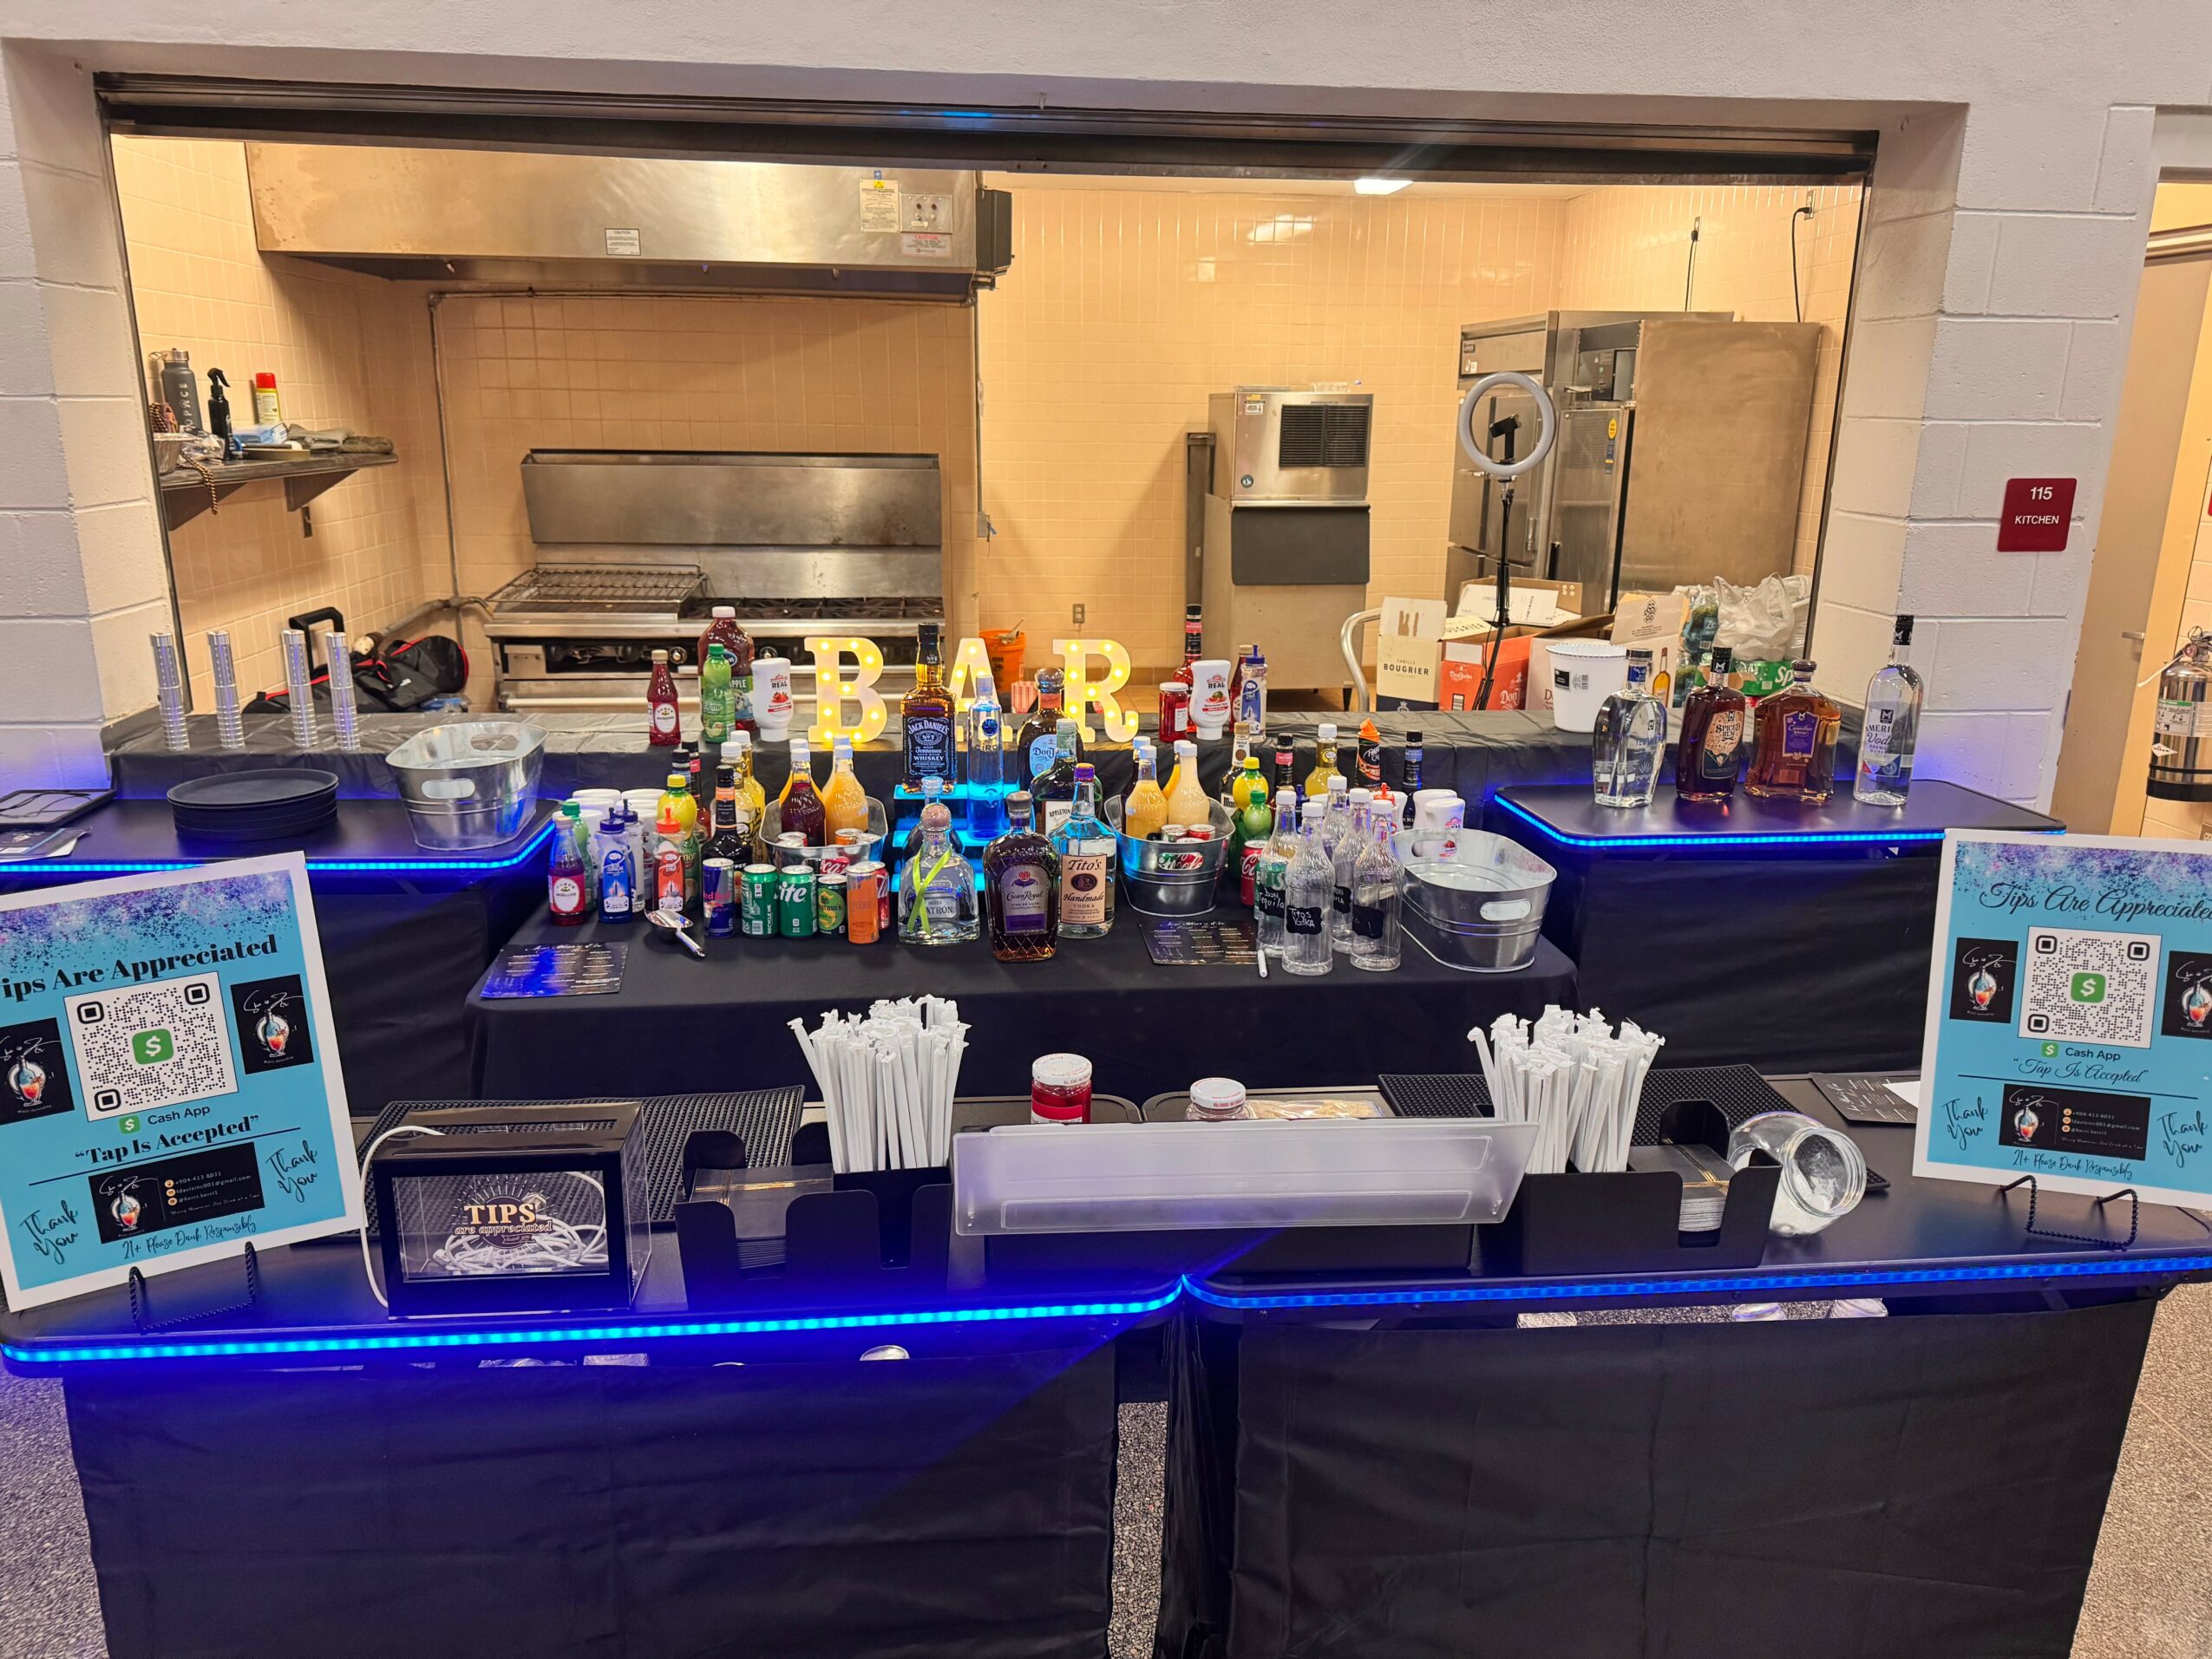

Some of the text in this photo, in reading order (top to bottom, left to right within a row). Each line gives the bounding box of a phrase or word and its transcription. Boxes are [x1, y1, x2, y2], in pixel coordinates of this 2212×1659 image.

[2030, 487, 2053, 500] 115
[2014, 515, 2059, 525] KITCHEN
[1384, 663, 1430, 676] BOUGRIER
[908, 720, 949, 735] JACK DANIEL'S
[1716, 722, 1740, 734] SPICED
[1049, 808, 1071, 817] APPLETON
[1068, 859, 1102, 871] Tito's
[1005, 891, 1044, 902] Crown Royal
[1063, 892, 1104, 902] Handmade
[1980, 882, 2212, 922] Tips Are Appreciate
[0, 934, 278, 1003] ips Are Appreciated
[2065, 1047, 2122, 1061] Cash App
[2055, 1061, 2081, 1078] Is
[147, 1105, 210, 1125] Cash App
[1942, 1096, 1988, 1127] Thank
[2157, 1110, 2209, 1141] Thank
[132, 1139, 151, 1154] Is
[1947, 1124, 1984, 1151] You
[265, 1139, 317, 1180] Thank
[2163, 1138, 2203, 1169] You
[2012, 1149, 2133, 1180] 21+ Please Drink Responsibly
[278, 1172, 318, 1203] You
[19, 1199, 79, 1244] Thank
[464, 1203, 536, 1225] TIPS
[122, 1214, 257, 1259] 21+ Please Drink Responsibly
[455, 1219, 553, 1236] are appreciated
[33, 1231, 79, 1264] You
